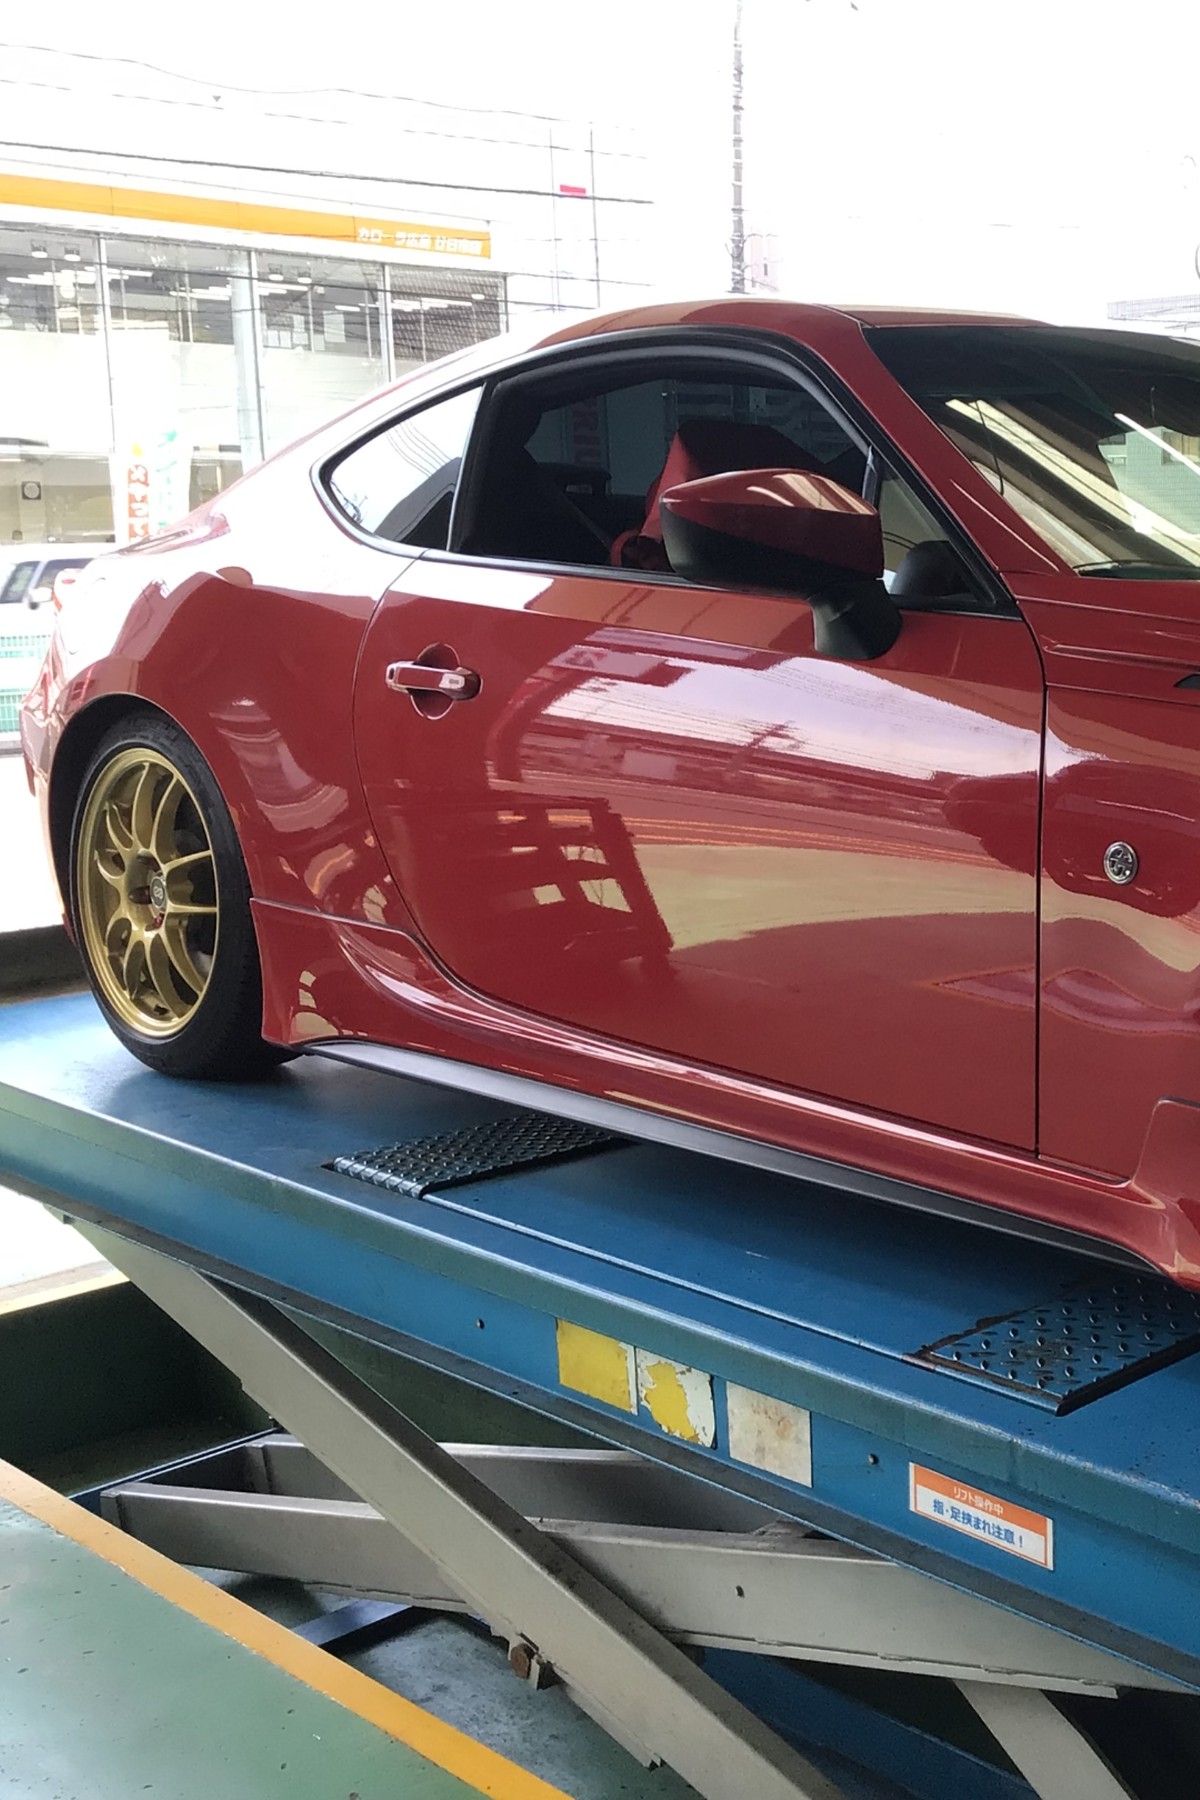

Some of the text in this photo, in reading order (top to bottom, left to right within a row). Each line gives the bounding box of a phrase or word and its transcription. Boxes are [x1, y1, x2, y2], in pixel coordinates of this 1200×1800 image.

[953, 1486, 1004, 1515] リフト操作中
